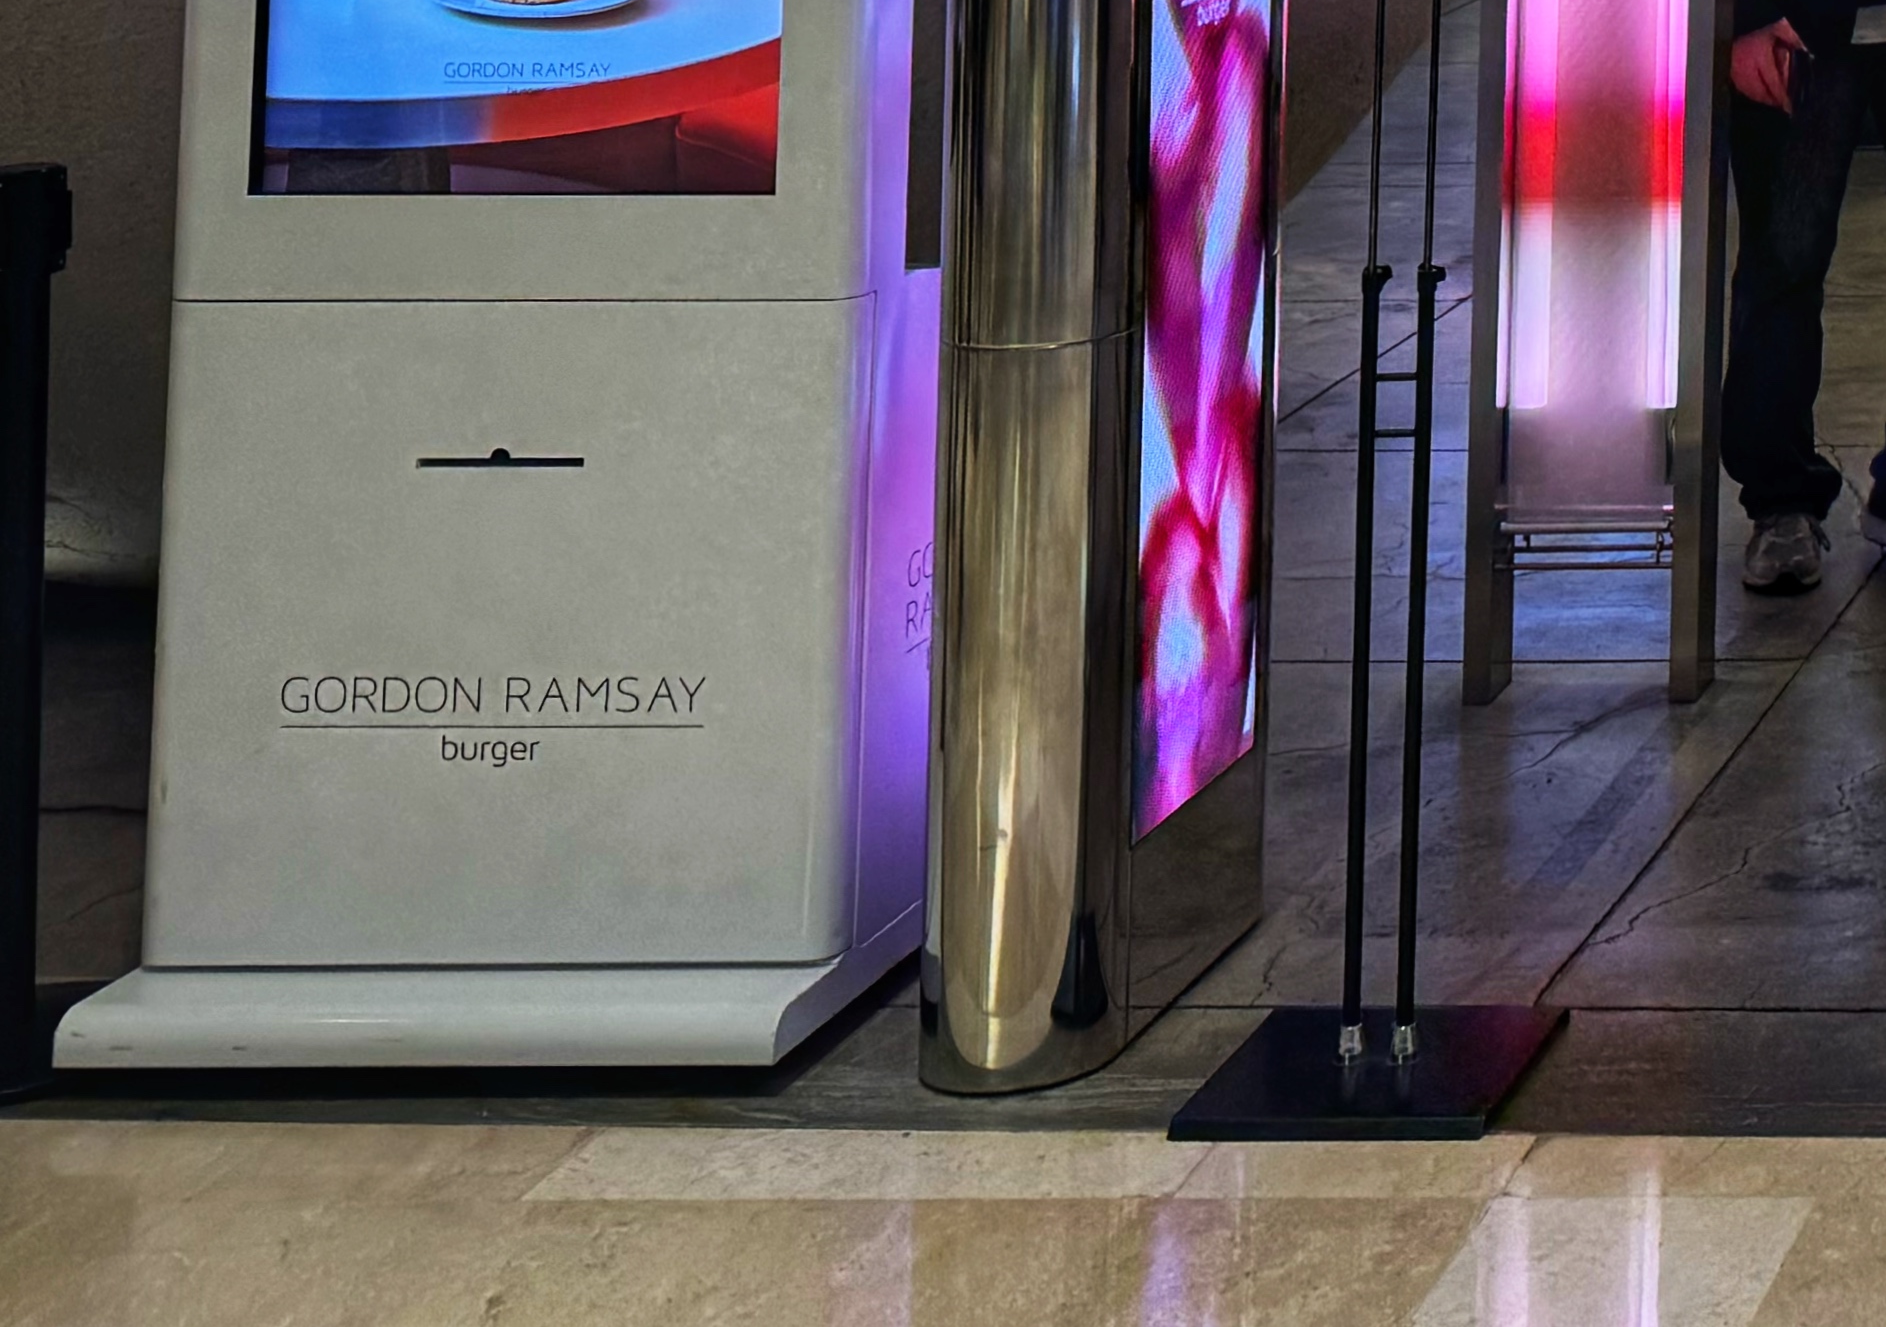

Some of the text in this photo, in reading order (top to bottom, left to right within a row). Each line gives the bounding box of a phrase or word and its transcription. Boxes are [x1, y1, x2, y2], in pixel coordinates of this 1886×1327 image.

[444, 62, 612, 79] GORDON RAMSAY
[280, 676, 706, 714] GORDON RAMSAY
[440, 734, 541, 768] burger
